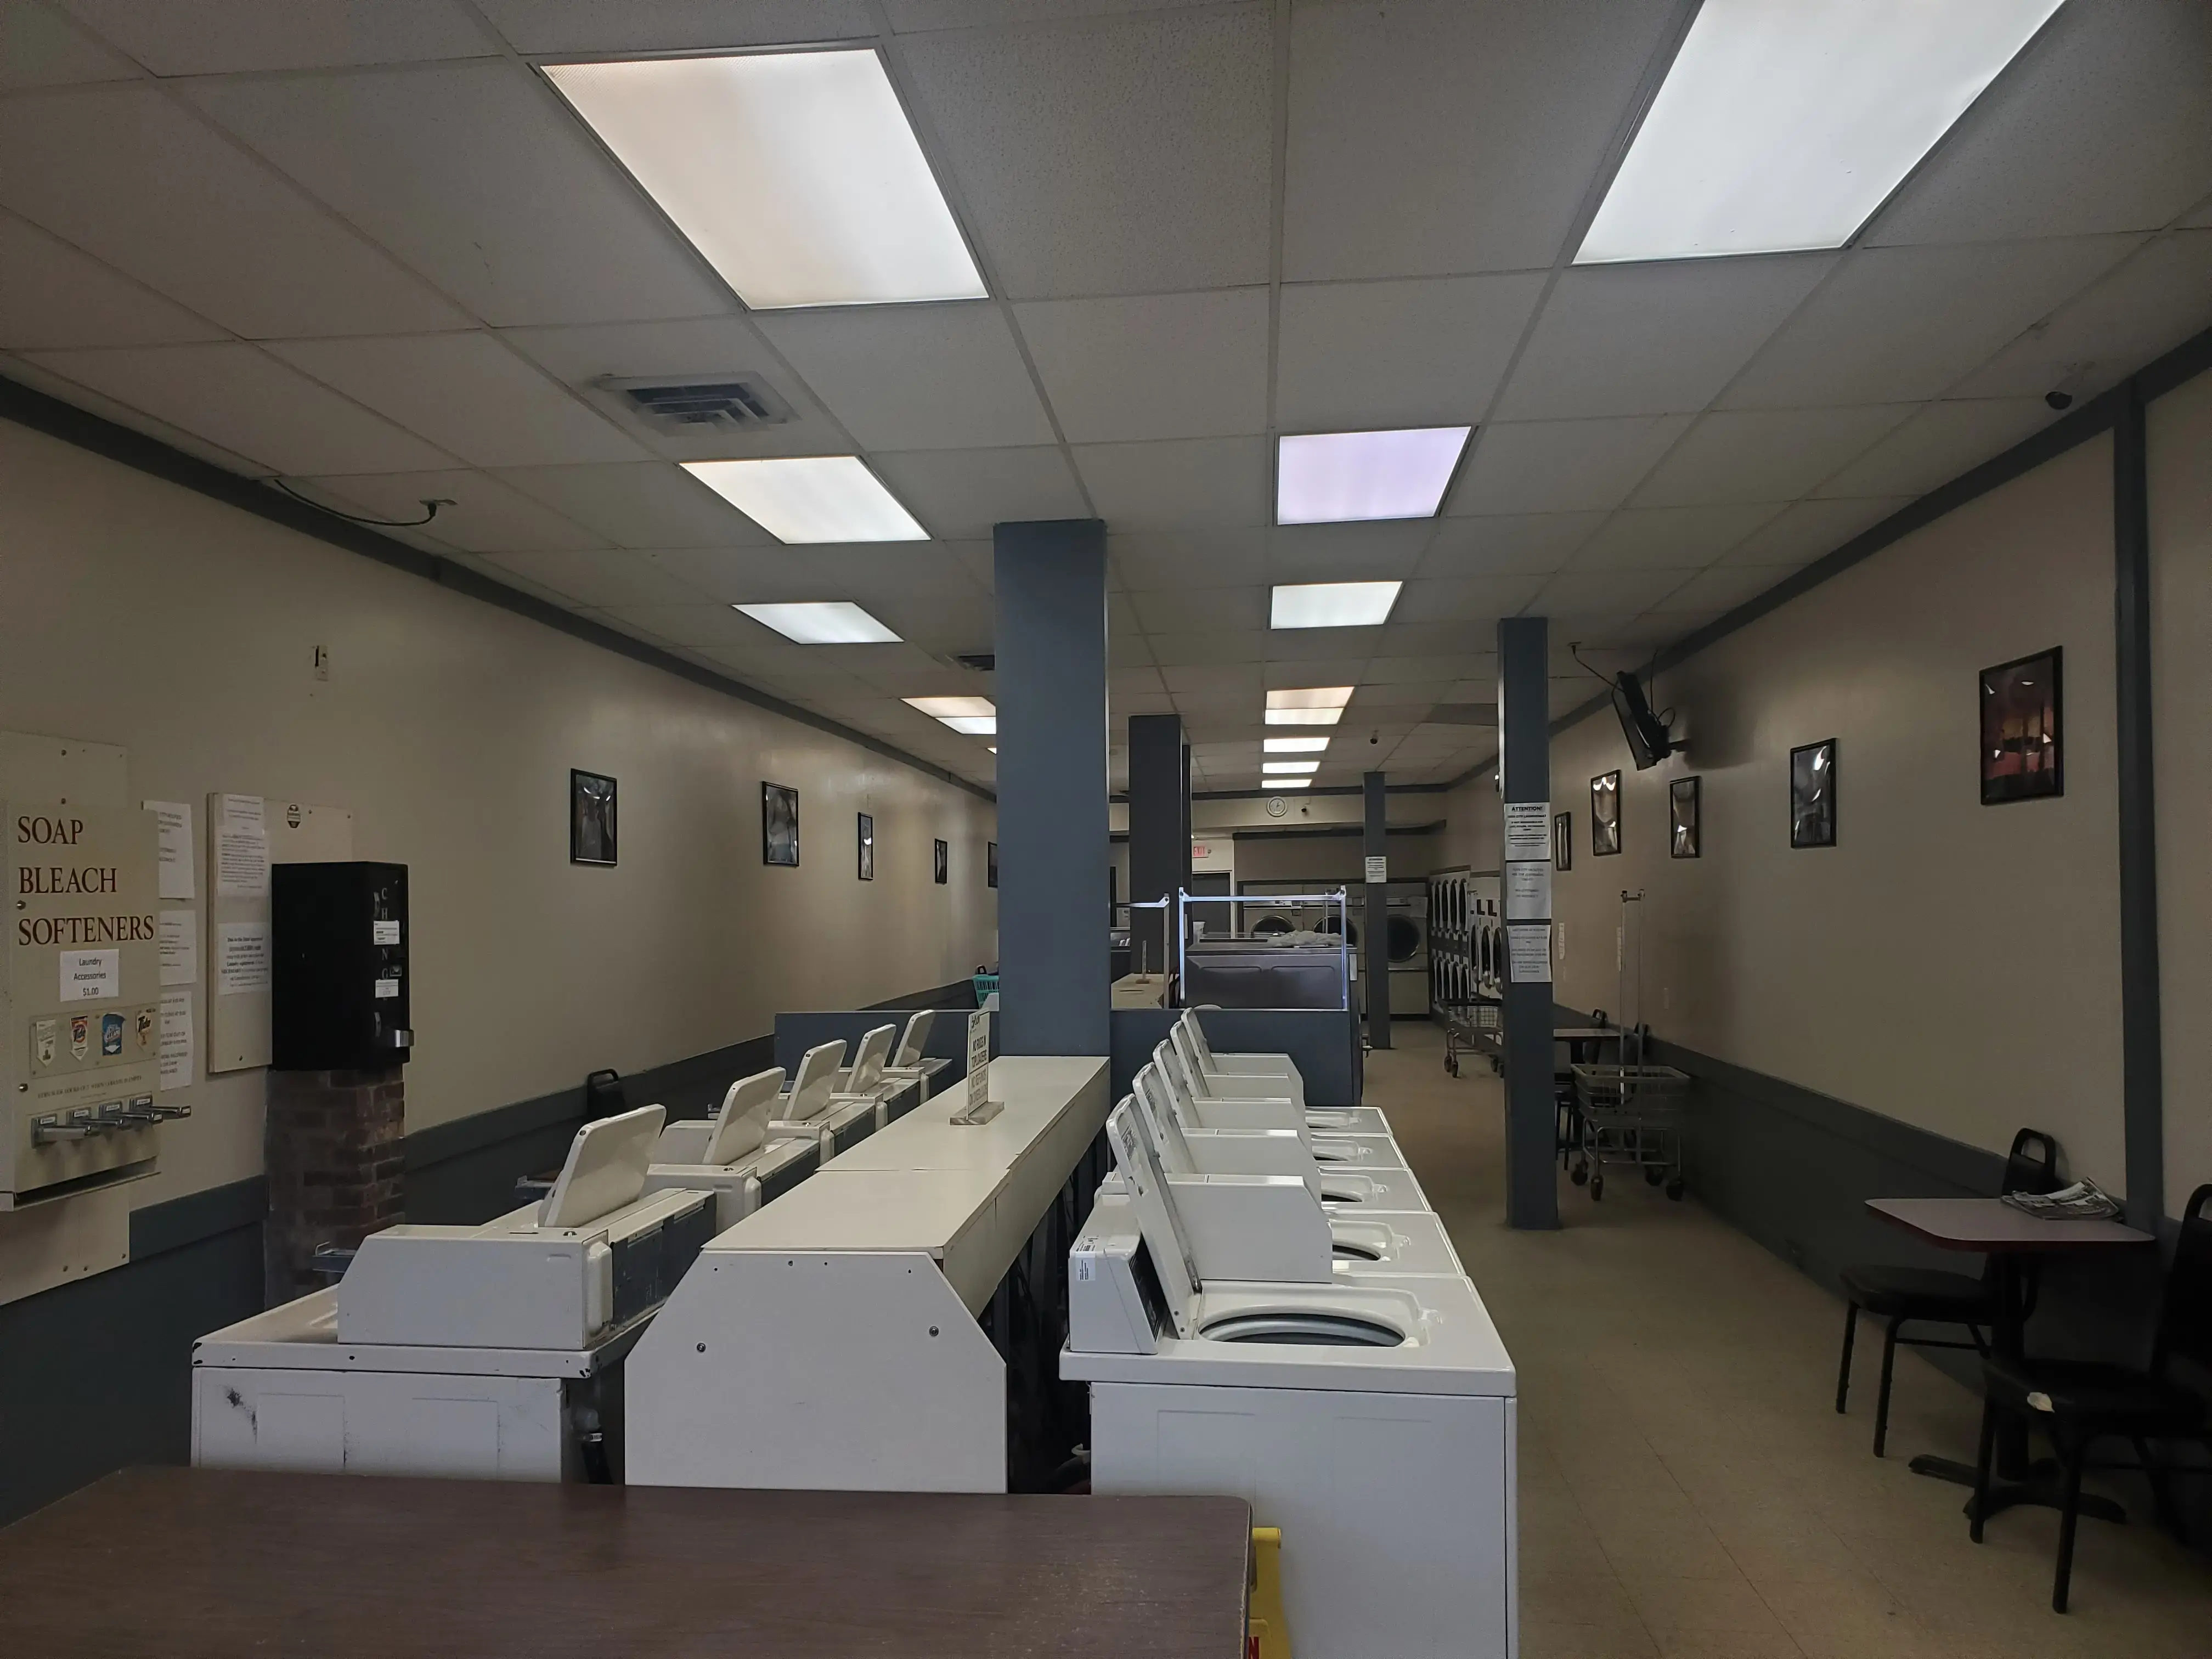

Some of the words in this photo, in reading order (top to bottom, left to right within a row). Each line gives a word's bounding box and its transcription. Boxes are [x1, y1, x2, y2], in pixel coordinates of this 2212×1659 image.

[18, 816, 84, 845] SOAP
[19, 867, 117, 894] BLEACH
[18, 915, 154, 946] SOFTENERS
[79, 957, 103, 967] Laundry
[74, 970, 106, 981] Accessories
[83, 986, 99, 997] $1.00
[138, 1015, 151, 1032] Tide
[73, 1027, 86, 1042] Tide
